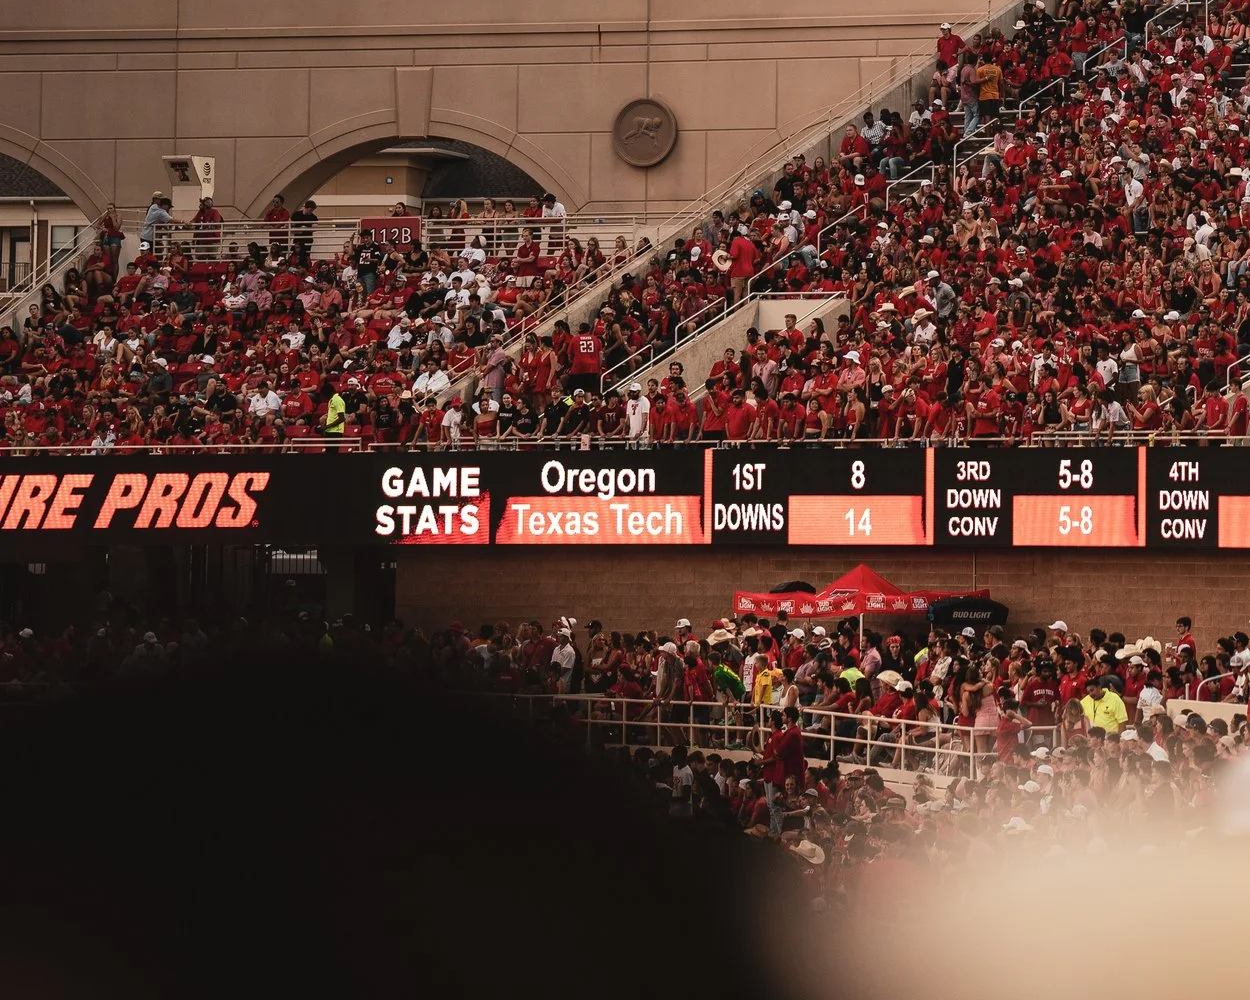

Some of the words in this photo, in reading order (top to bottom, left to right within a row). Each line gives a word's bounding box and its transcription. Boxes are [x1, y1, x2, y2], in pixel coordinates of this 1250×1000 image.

[579, 341, 594, 353] 23
[382, 467, 480, 497] GAME
[541, 460, 656, 500] Oregon
[732, 464, 766, 490] 1ST
[851, 460, 866, 489] 8
[956, 461, 991, 481] 3RD
[1058, 459, 1093, 489] 5-8
[1169, 461, 1199, 482] 4TH
[0, 474, 95, 530] IRE
[93, 472, 271, 529] PROS
[947, 489, 1001, 508] DOWN
[1159, 490, 1209, 511] DOWN
[375, 504, 480, 535] STATS
[511, 504, 599, 535] Texas
[610, 503, 683, 535] Tech
[714, 504, 784, 531] DOWNS
[844, 508, 872, 536] 14
[948, 517, 998, 536] CONV
[1058, 506, 1093, 535] 5-8
[1161, 519, 1206, 539] CONV
[969, 611, 992, 619] LIGHT
